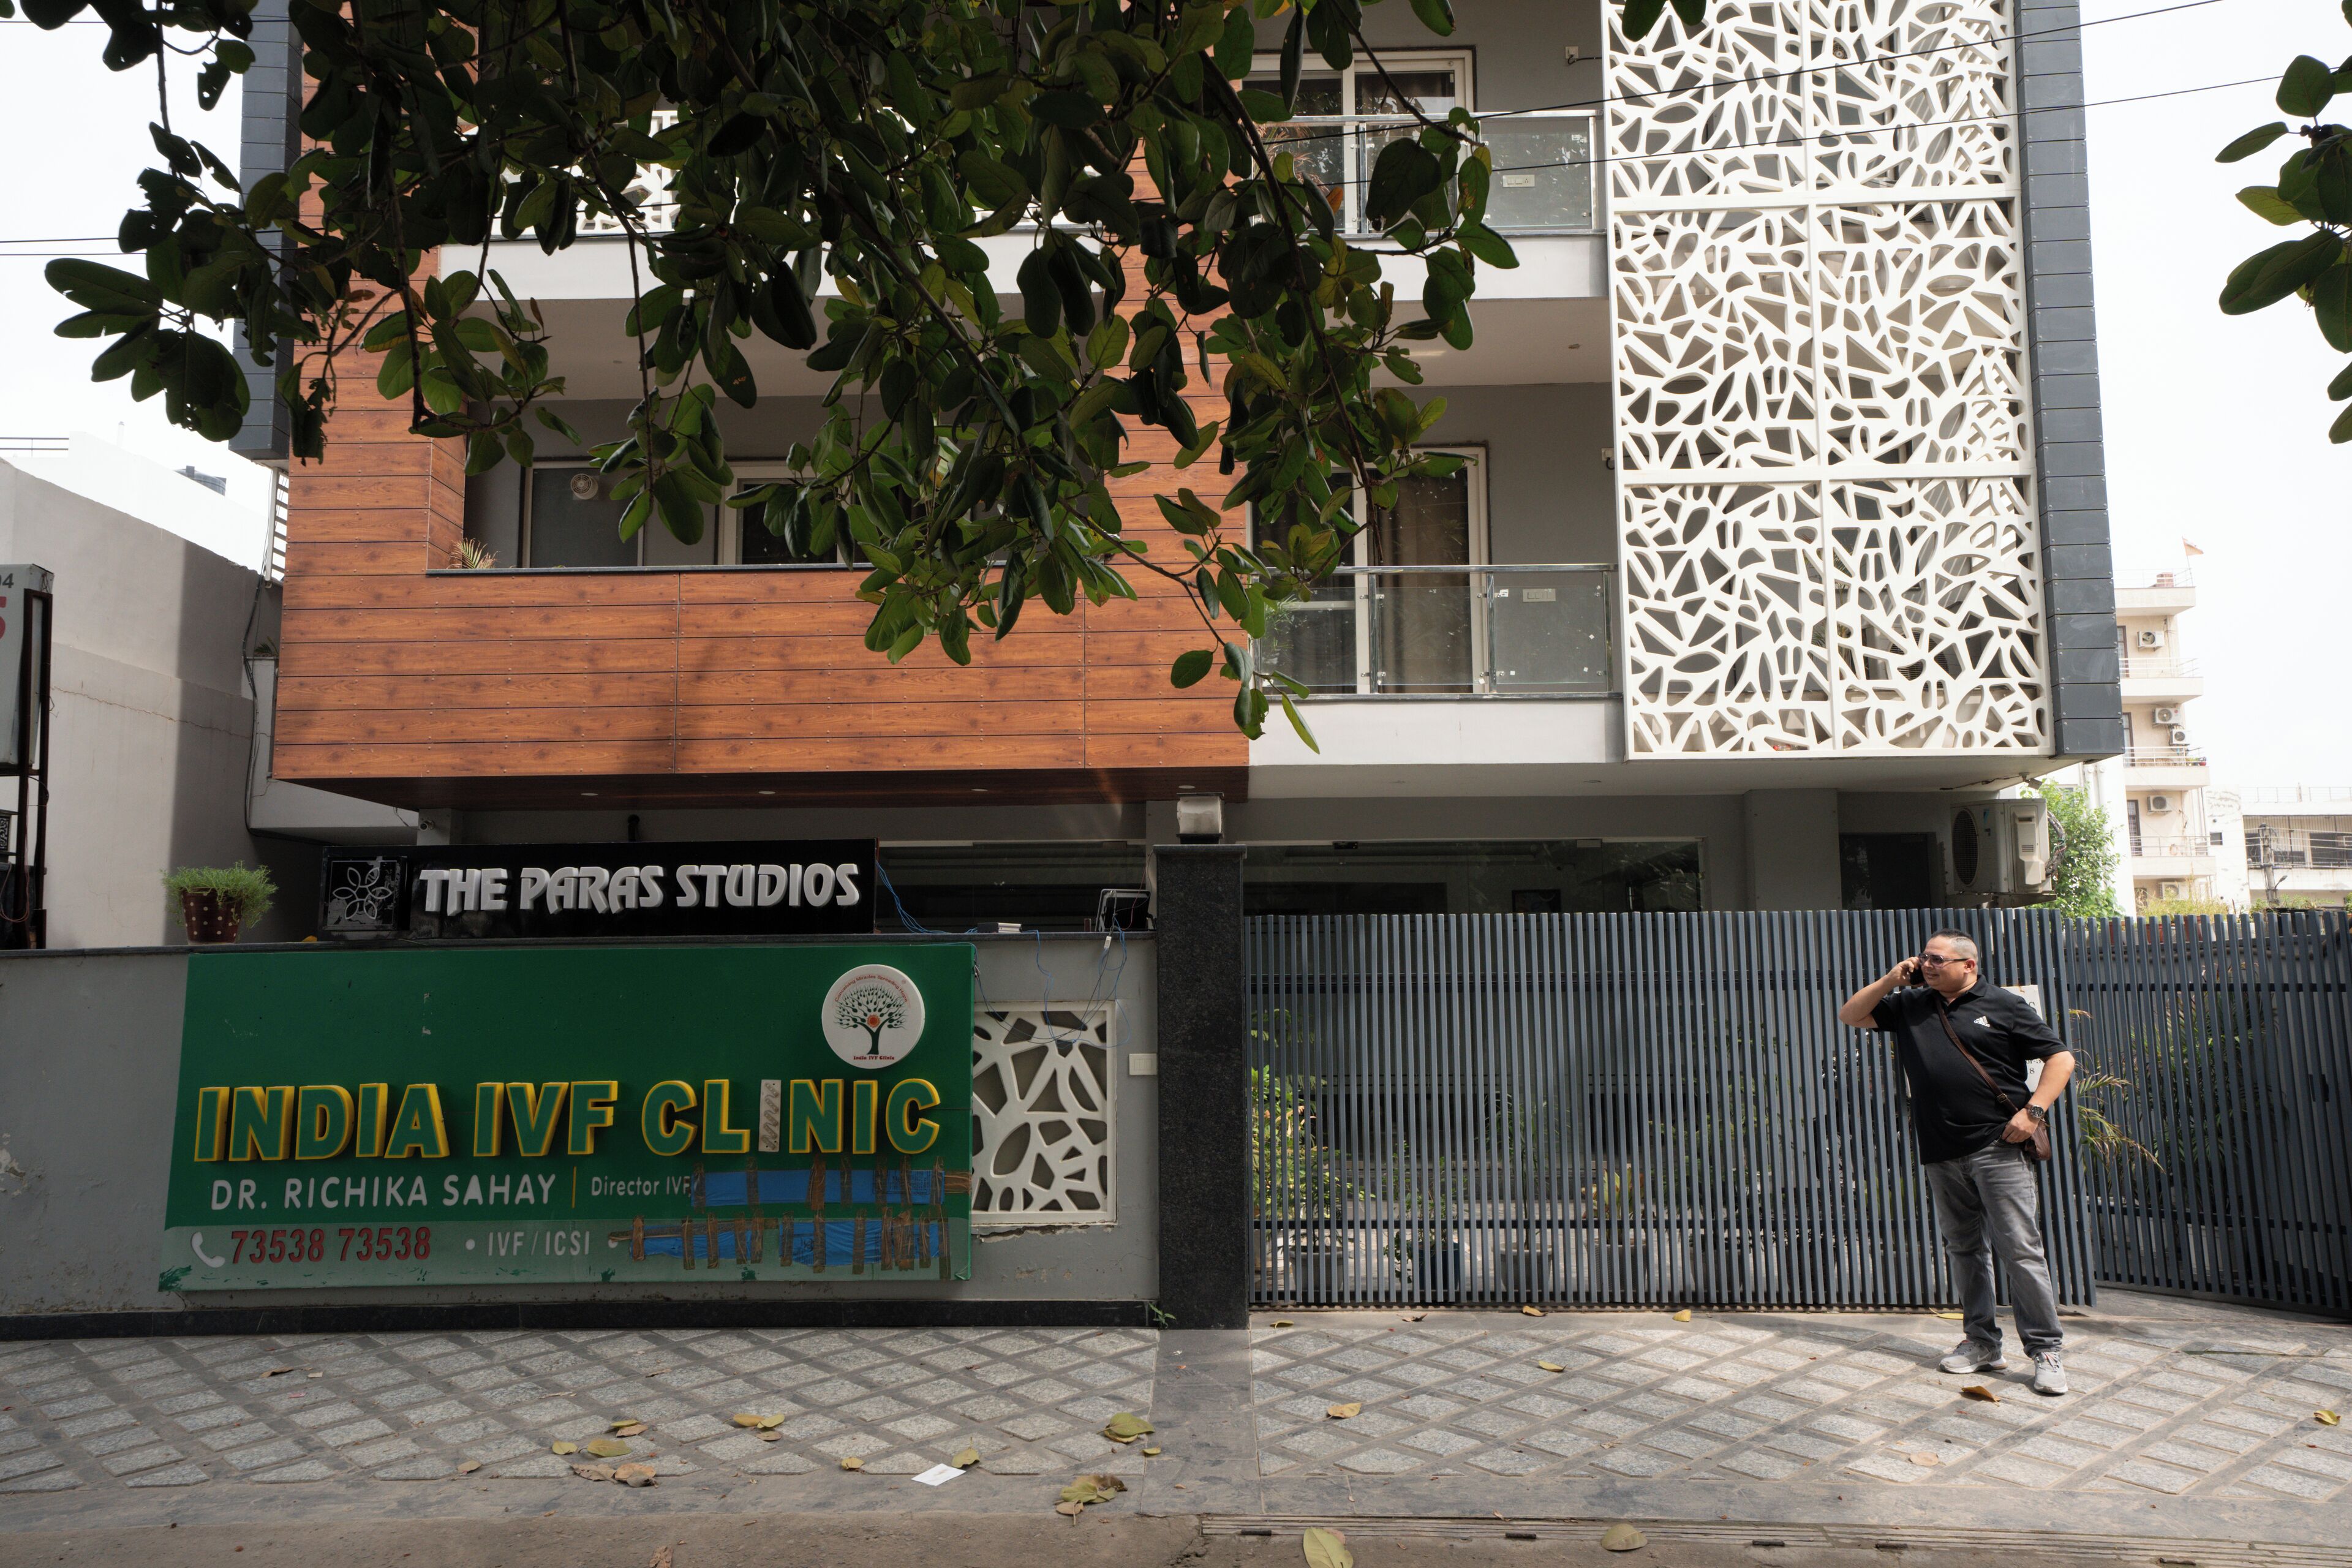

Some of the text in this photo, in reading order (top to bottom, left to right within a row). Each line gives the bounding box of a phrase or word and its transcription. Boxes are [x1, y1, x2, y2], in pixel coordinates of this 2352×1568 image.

[419, 863, 859, 916] THE PARAS STUDIOS
[835, 979, 856, 1002] Conceiving
[877, 974, 899, 990] Spreading
[899, 988, 908, 1003] Hope
[194, 1083, 450, 1162] INDIA
[473, 1080, 618, 1157] IVF
[211, 1174, 556, 1210] DR. RICHIKA SAHAY
[591, 1176, 660, 1197] Director
[231, 1226, 431, 1264] 73538 73538
